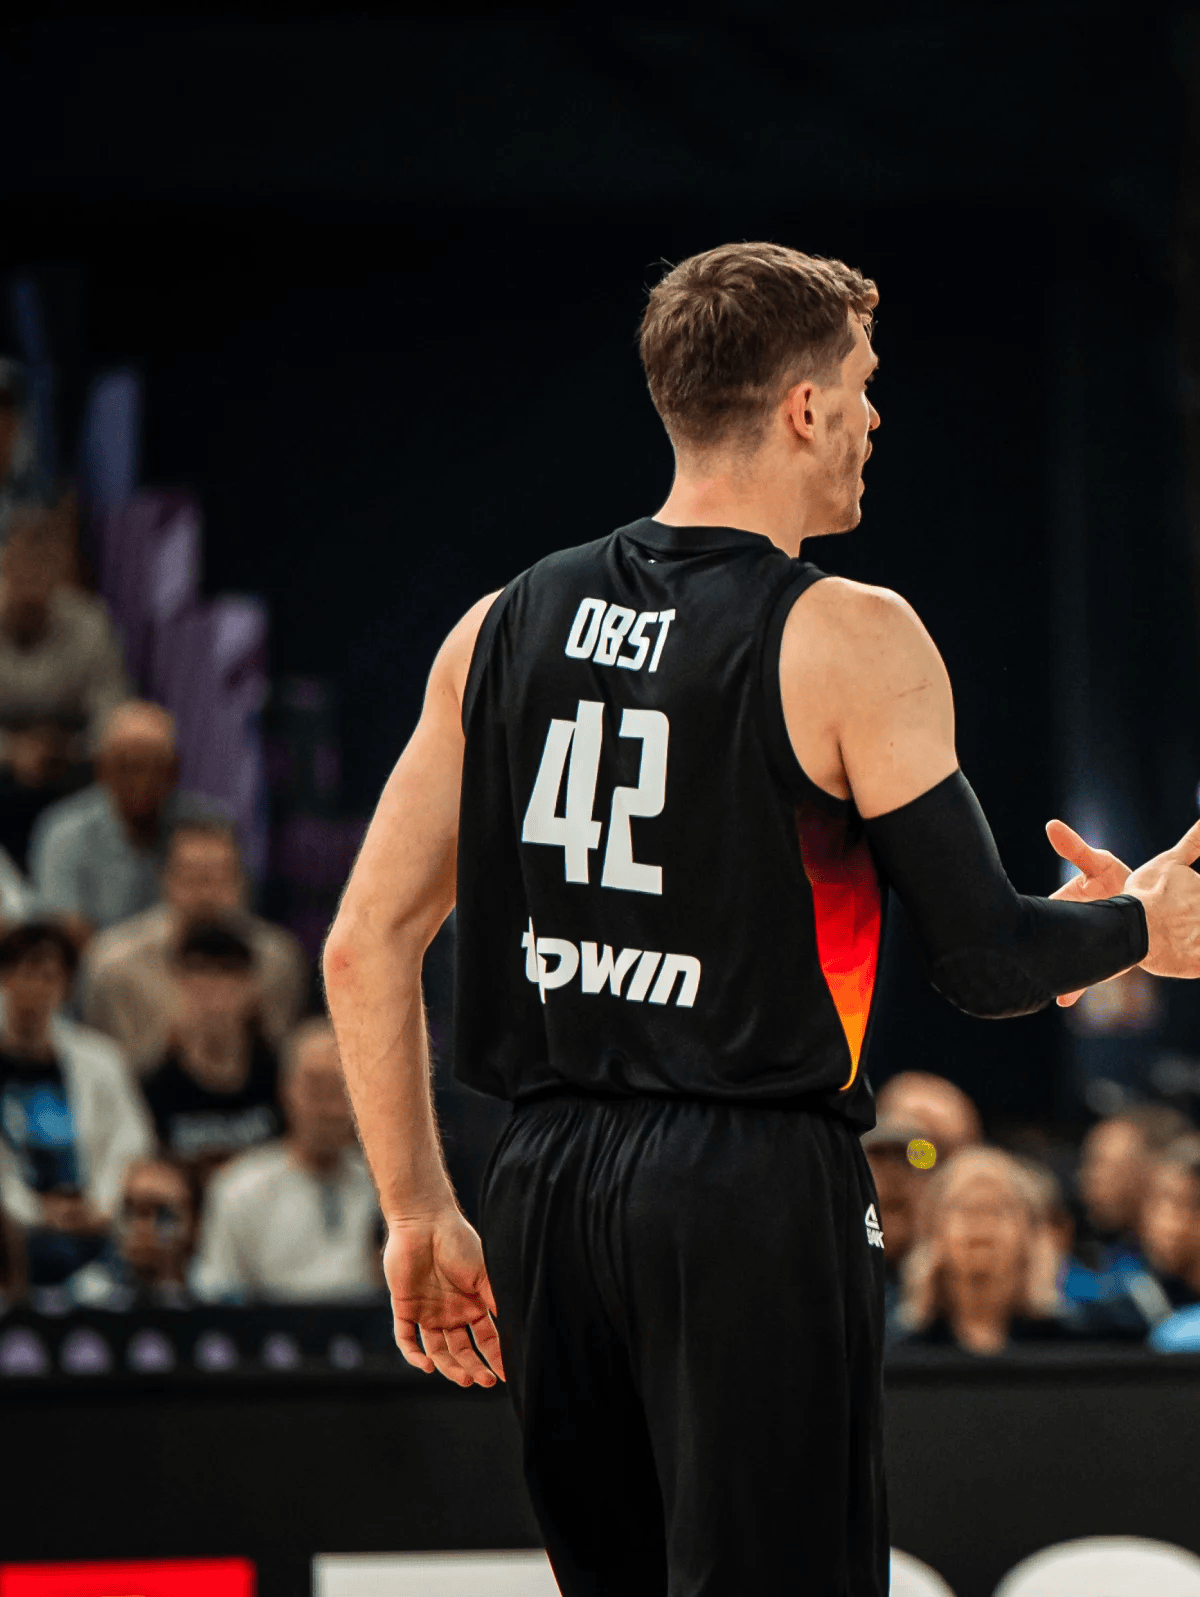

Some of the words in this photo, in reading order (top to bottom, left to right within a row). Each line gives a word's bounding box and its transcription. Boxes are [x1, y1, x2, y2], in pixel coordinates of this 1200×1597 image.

[564, 597, 676, 673] OBST
[521, 699, 669, 895] 42
[521, 916, 701, 1008] tpwin
